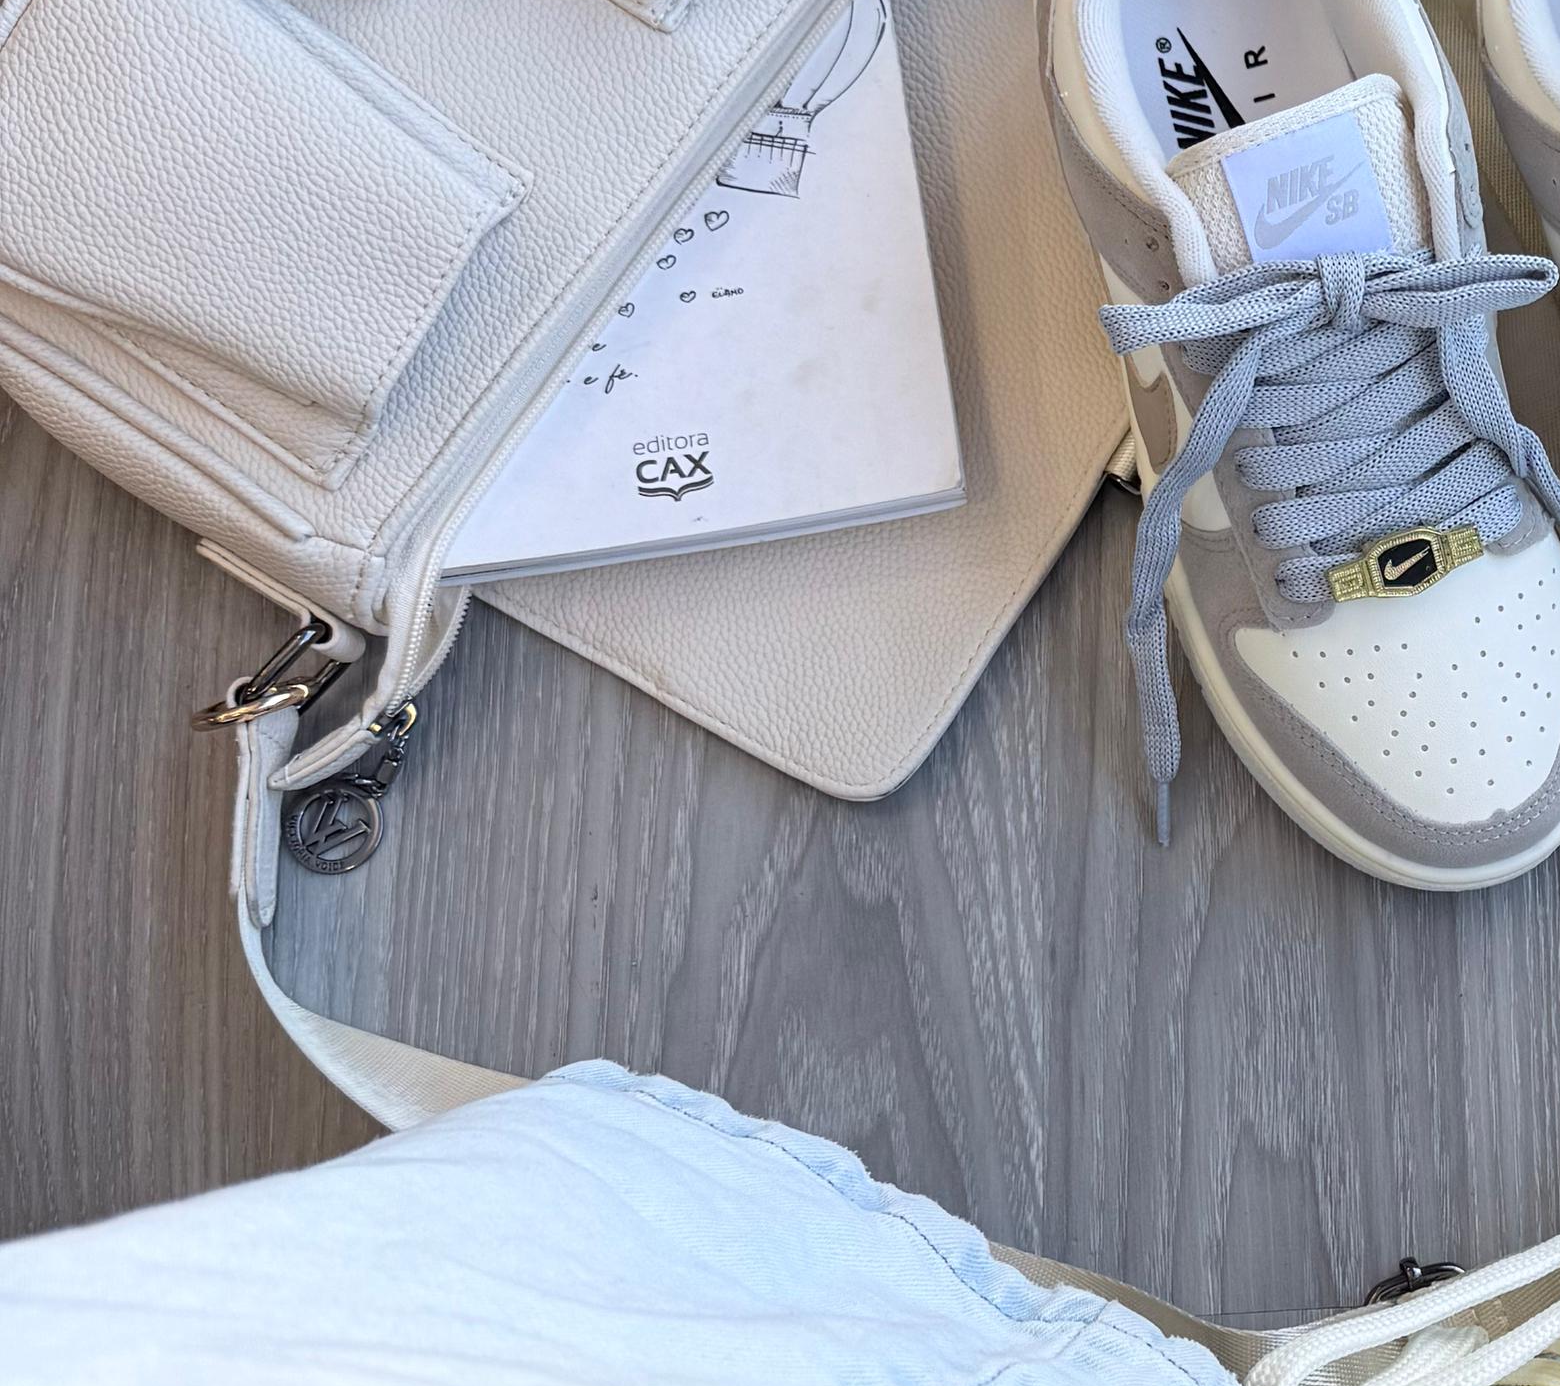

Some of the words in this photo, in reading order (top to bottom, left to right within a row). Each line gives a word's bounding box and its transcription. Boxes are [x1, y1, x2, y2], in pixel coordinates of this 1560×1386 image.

[1266, 155, 1335, 214] NIKE
[1325, 189, 1359, 225] SB
[632, 432, 710, 456] editora
[635, 450, 712, 484] CAX
